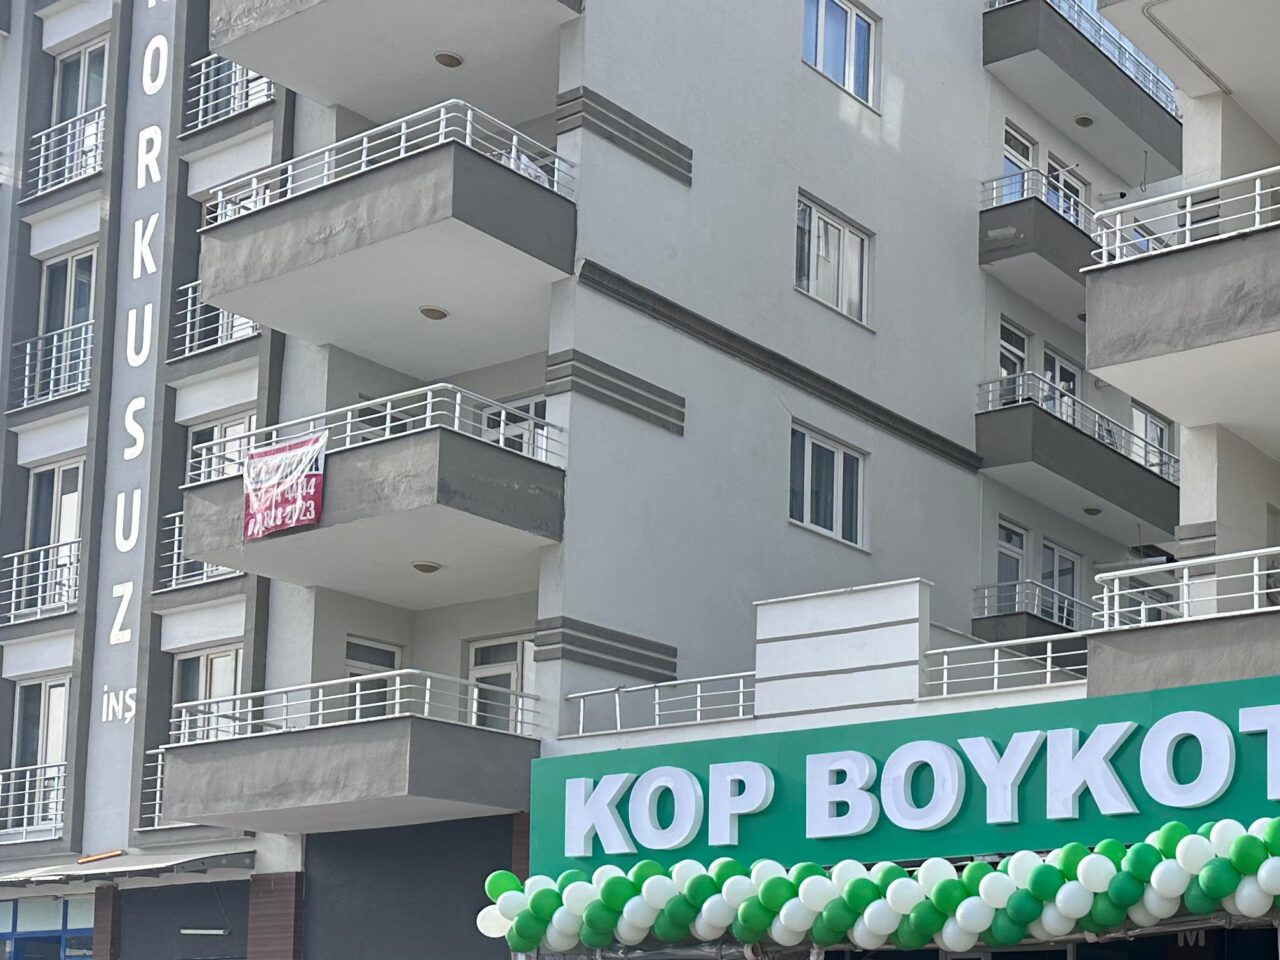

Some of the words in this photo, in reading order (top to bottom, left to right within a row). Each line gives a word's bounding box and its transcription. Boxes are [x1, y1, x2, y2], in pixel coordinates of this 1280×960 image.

[108, 0, 168, 645] ORKUSUZ
[102, 684, 137, 724] İNŞ
[564, 760, 775, 858] KOP
